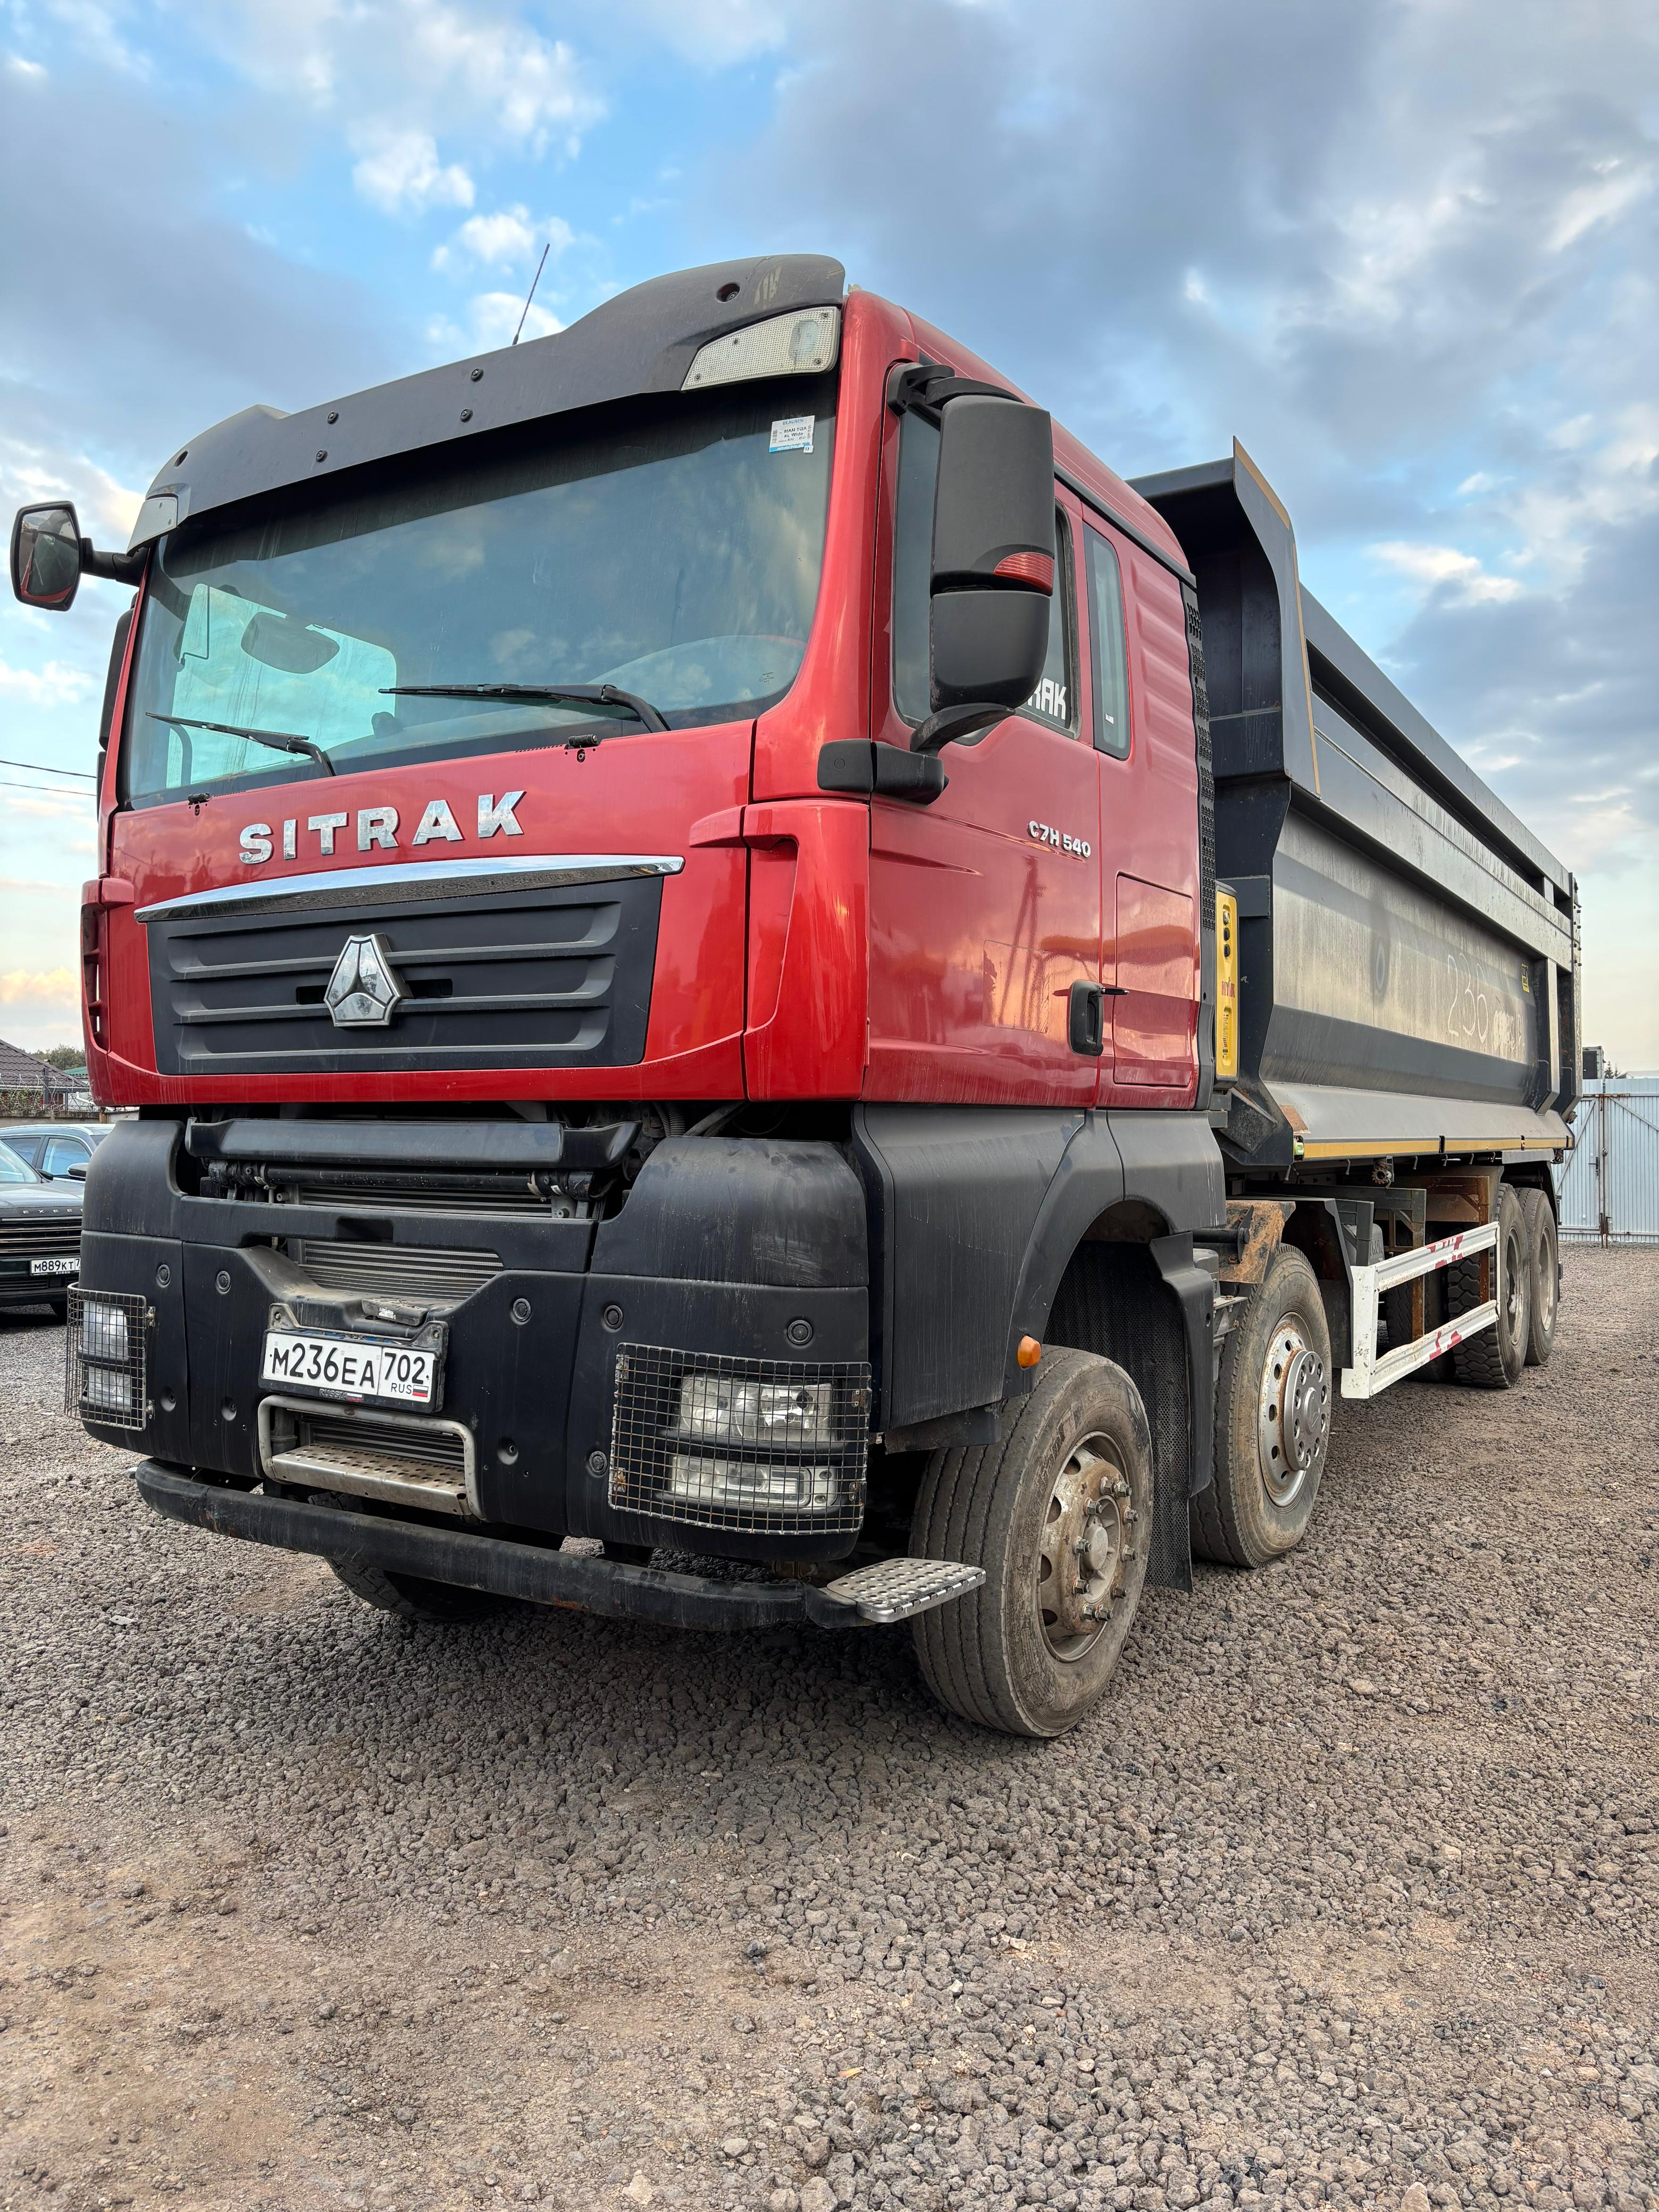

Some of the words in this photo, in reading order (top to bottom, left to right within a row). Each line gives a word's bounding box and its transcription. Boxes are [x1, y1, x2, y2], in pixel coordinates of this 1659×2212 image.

[239, 790, 527, 865] SITRAK
[1028, 820, 1059, 847] C7H
[1062, 833, 1091, 858] 540
[1447, 953, 1488, 1044] 236
[384, 1352, 425, 1385] 702
[391, 1382, 412, 1394] RUS
